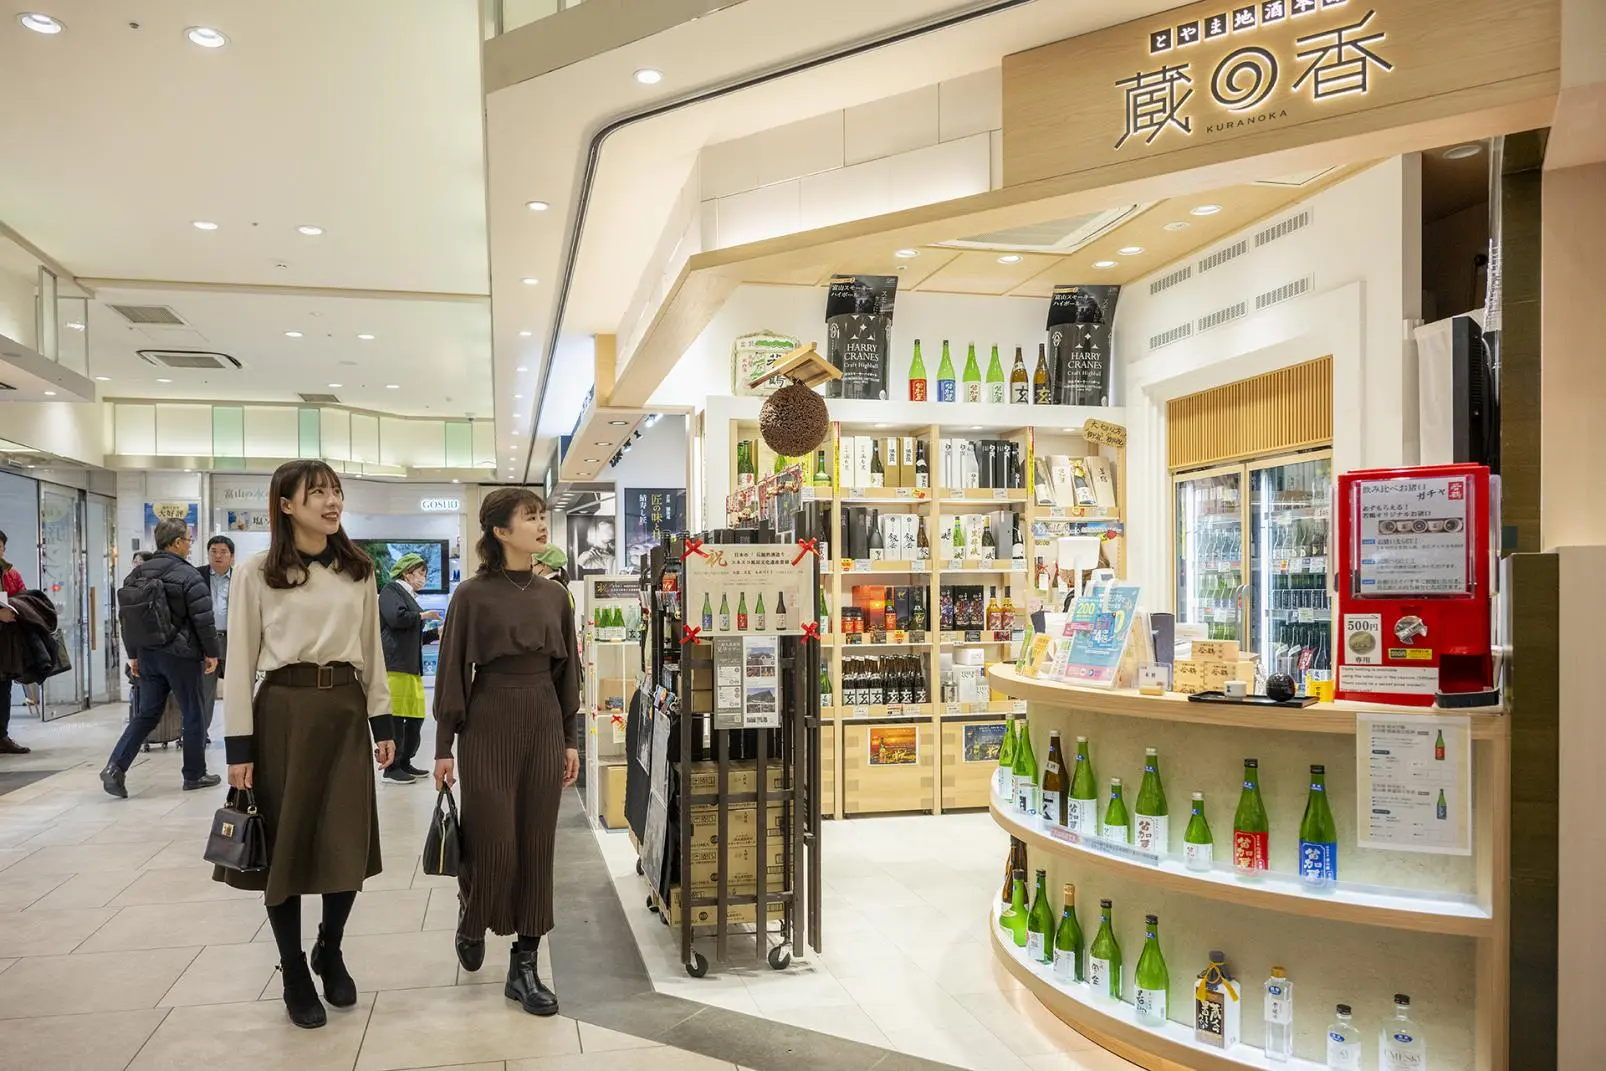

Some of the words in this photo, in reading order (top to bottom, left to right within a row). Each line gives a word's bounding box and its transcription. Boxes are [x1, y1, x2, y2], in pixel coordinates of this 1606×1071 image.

[1206, 109, 1288, 133] KURANOKA
[847, 343, 878, 354] HARRY
[843, 352, 880, 363] CRANES
[1071, 352, 1102, 361] HARRY
[843, 361, 858, 369] Craft
[858, 362, 879, 370] Highball
[1067, 360, 1103, 370] CRANES
[1081, 370, 1102, 378] Highball
[1015, 385, 1029, 404] 玄
[704, 549, 728, 568] 祝
[1347, 620, 1379, 632] 500円
